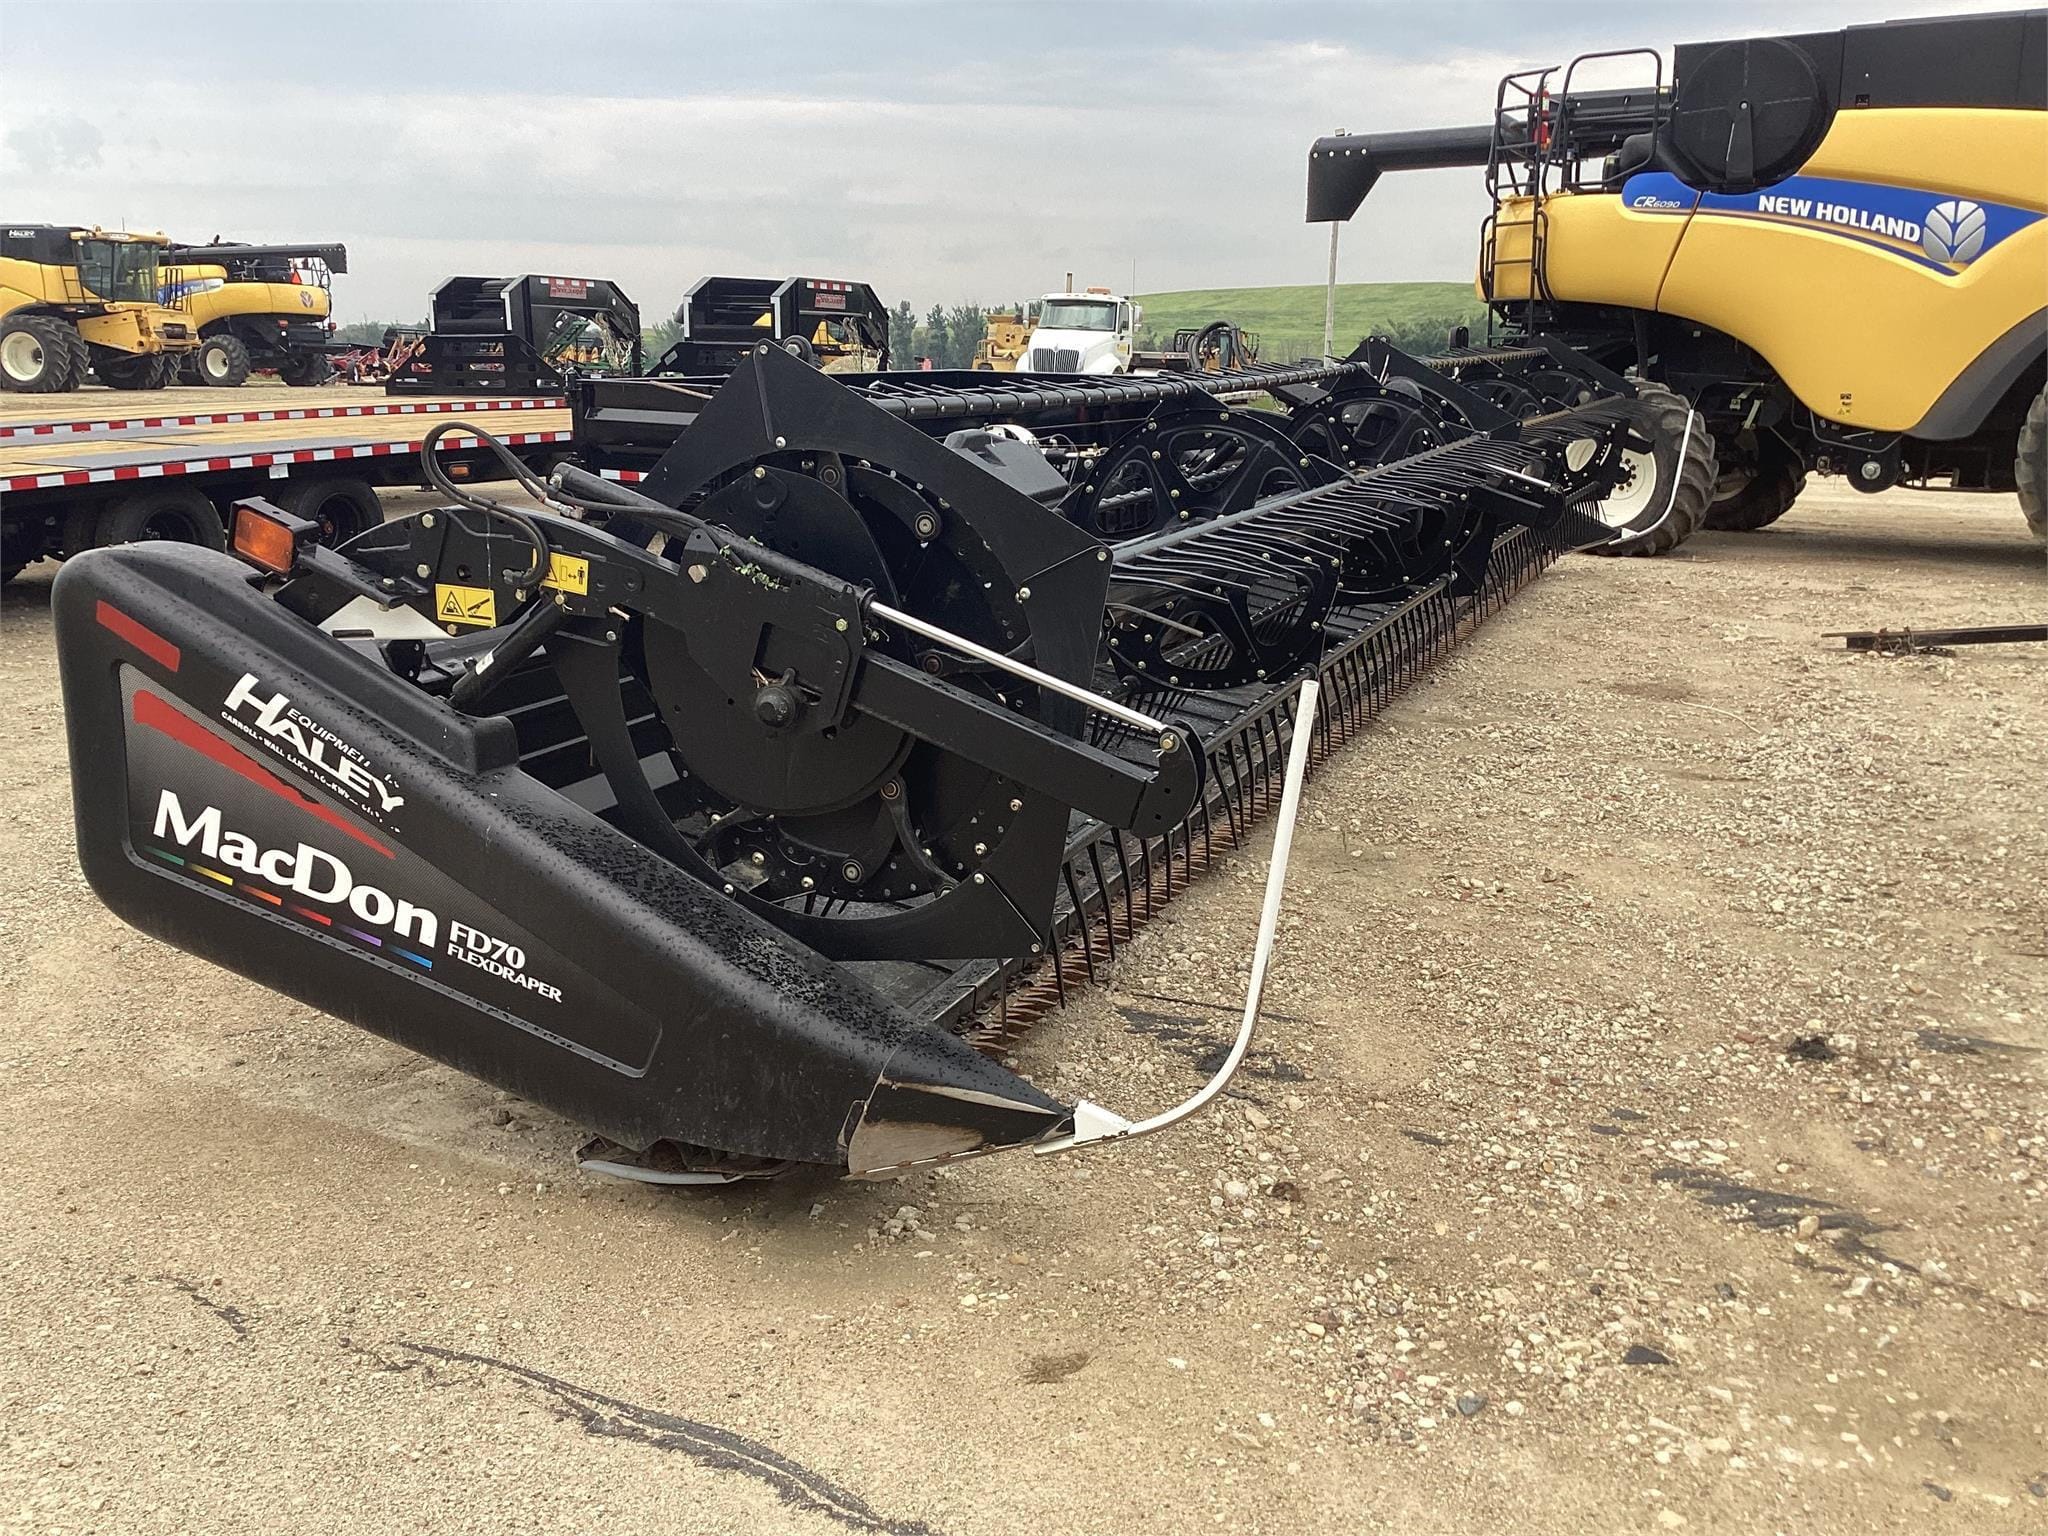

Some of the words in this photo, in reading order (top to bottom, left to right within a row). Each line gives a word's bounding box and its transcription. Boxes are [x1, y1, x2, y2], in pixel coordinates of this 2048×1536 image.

[1632, 195, 1681, 209] CR6090
[1758, 194, 1812, 218] NEW
[1815, 202, 1921, 243] HOLLAND
[220, 711, 259, 740] CARROLL
[263, 738, 285, 757] WALL
[223, 672, 405, 813] HALEY
[152, 788, 439, 948] MacDon
[449, 920, 527, 971] FD70
[446, 943, 563, 1004] FLEXDRAPER
